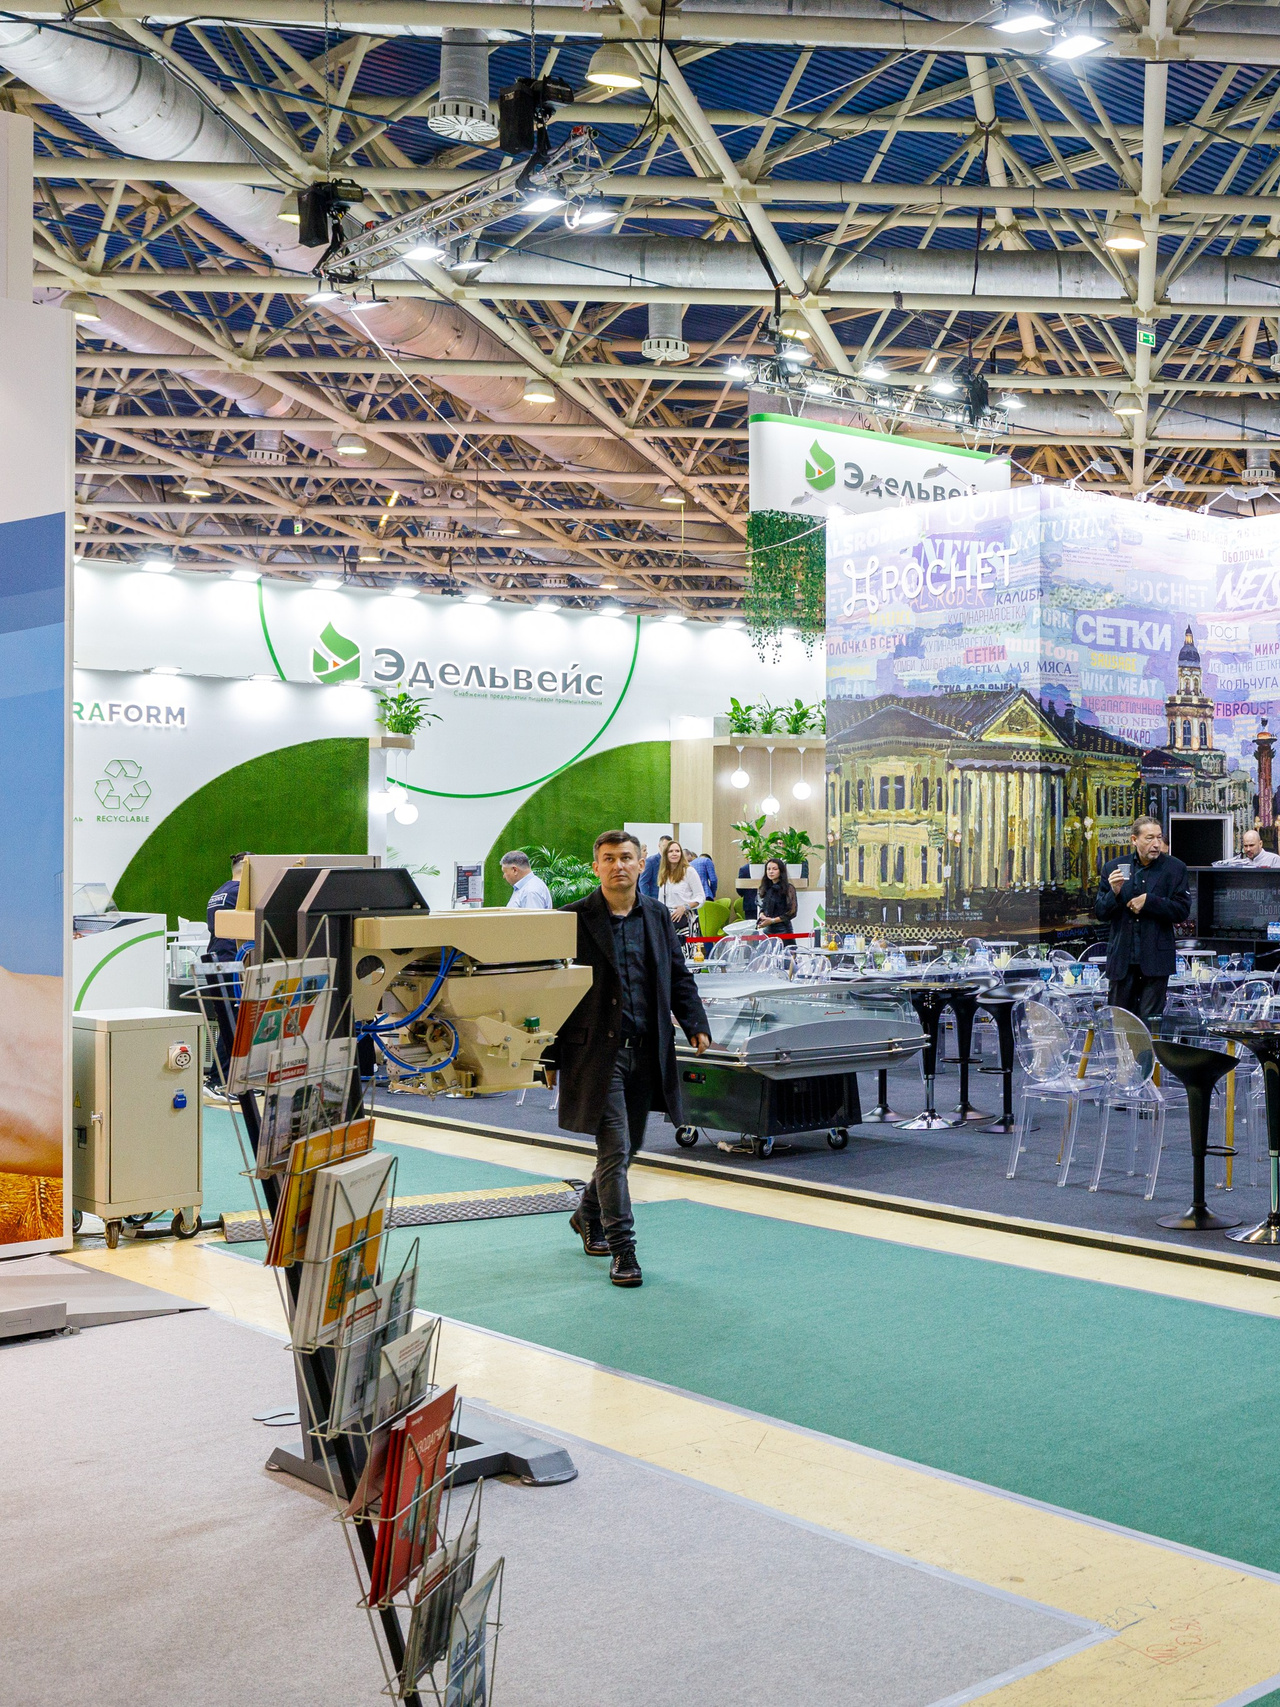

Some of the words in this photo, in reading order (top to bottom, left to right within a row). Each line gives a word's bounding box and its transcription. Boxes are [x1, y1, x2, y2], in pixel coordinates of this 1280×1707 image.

[1222, 548, 1264, 562] ОБОЛОЧКА
[995, 588, 1044, 604] КАЛИБР
[1001, 605, 1027, 618] СЕТКА
[1032, 608, 1071, 629] PORK
[1075, 614, 1172, 652] СЕТКИ
[1210, 624, 1239, 640] ГОСТ
[966, 646, 1006, 663] СЕТКИ
[1005, 637, 1079, 662] mutton
[1035, 661, 1072, 675] МЯСА
[1090, 653, 1137, 671] SAUSAGE
[374, 648, 603, 695] Эдельвейс
[1117, 674, 1158, 697] MEAT
[1219, 677, 1279, 690] КОЛЬЧУГА
[1215, 702, 1274, 717] FIBROUSE
[1100, 715, 1127, 726] TRIO
[1131, 716, 1160, 728] NETS
[1118, 727, 1150, 744] МИКРО
